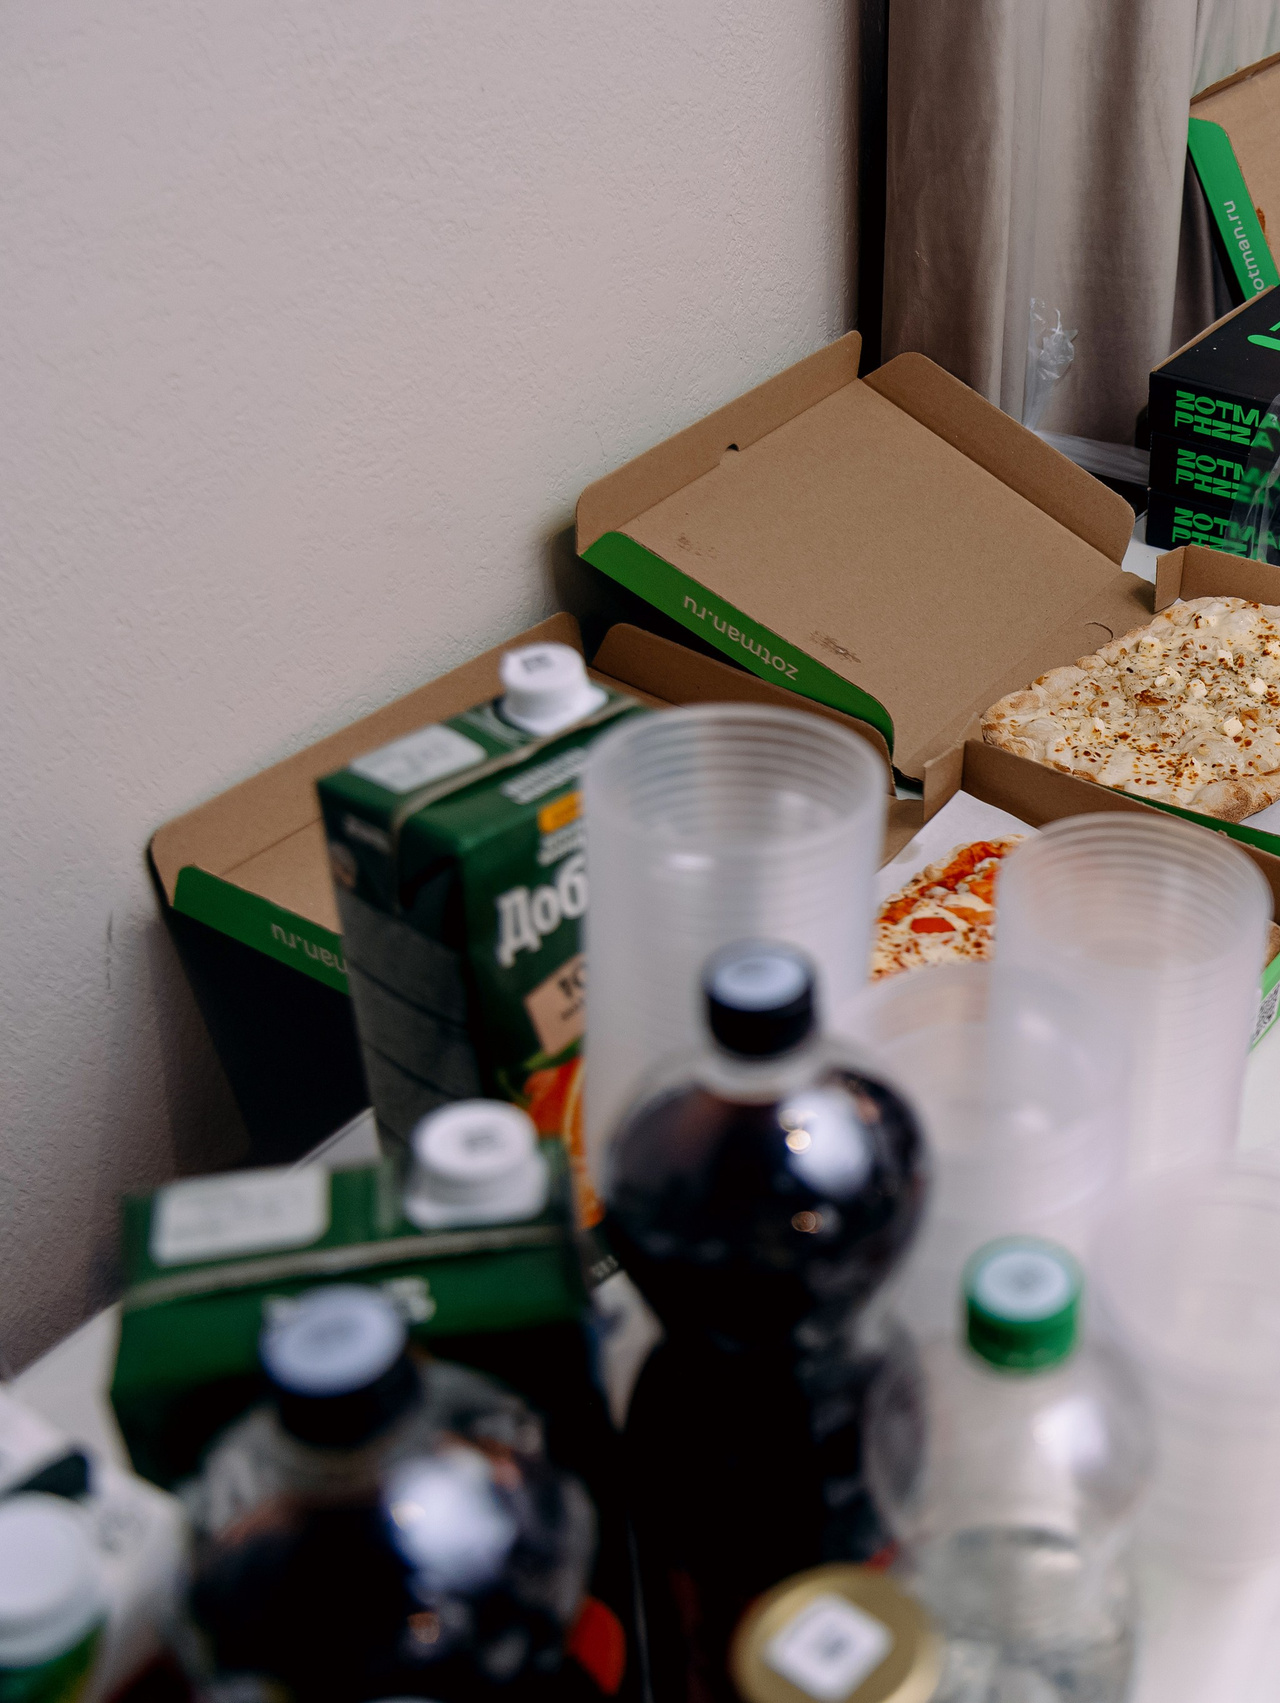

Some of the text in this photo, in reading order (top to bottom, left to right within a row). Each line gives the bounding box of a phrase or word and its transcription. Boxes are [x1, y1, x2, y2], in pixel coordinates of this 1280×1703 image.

[1223, 200, 1266, 295] otman.ru
[1174, 410, 1275, 452] PIZZA
[1175, 468, 1274, 510] PIZZA
[683, 595, 799, 682] zotman.ru
[495, 855, 590, 968] Доб
